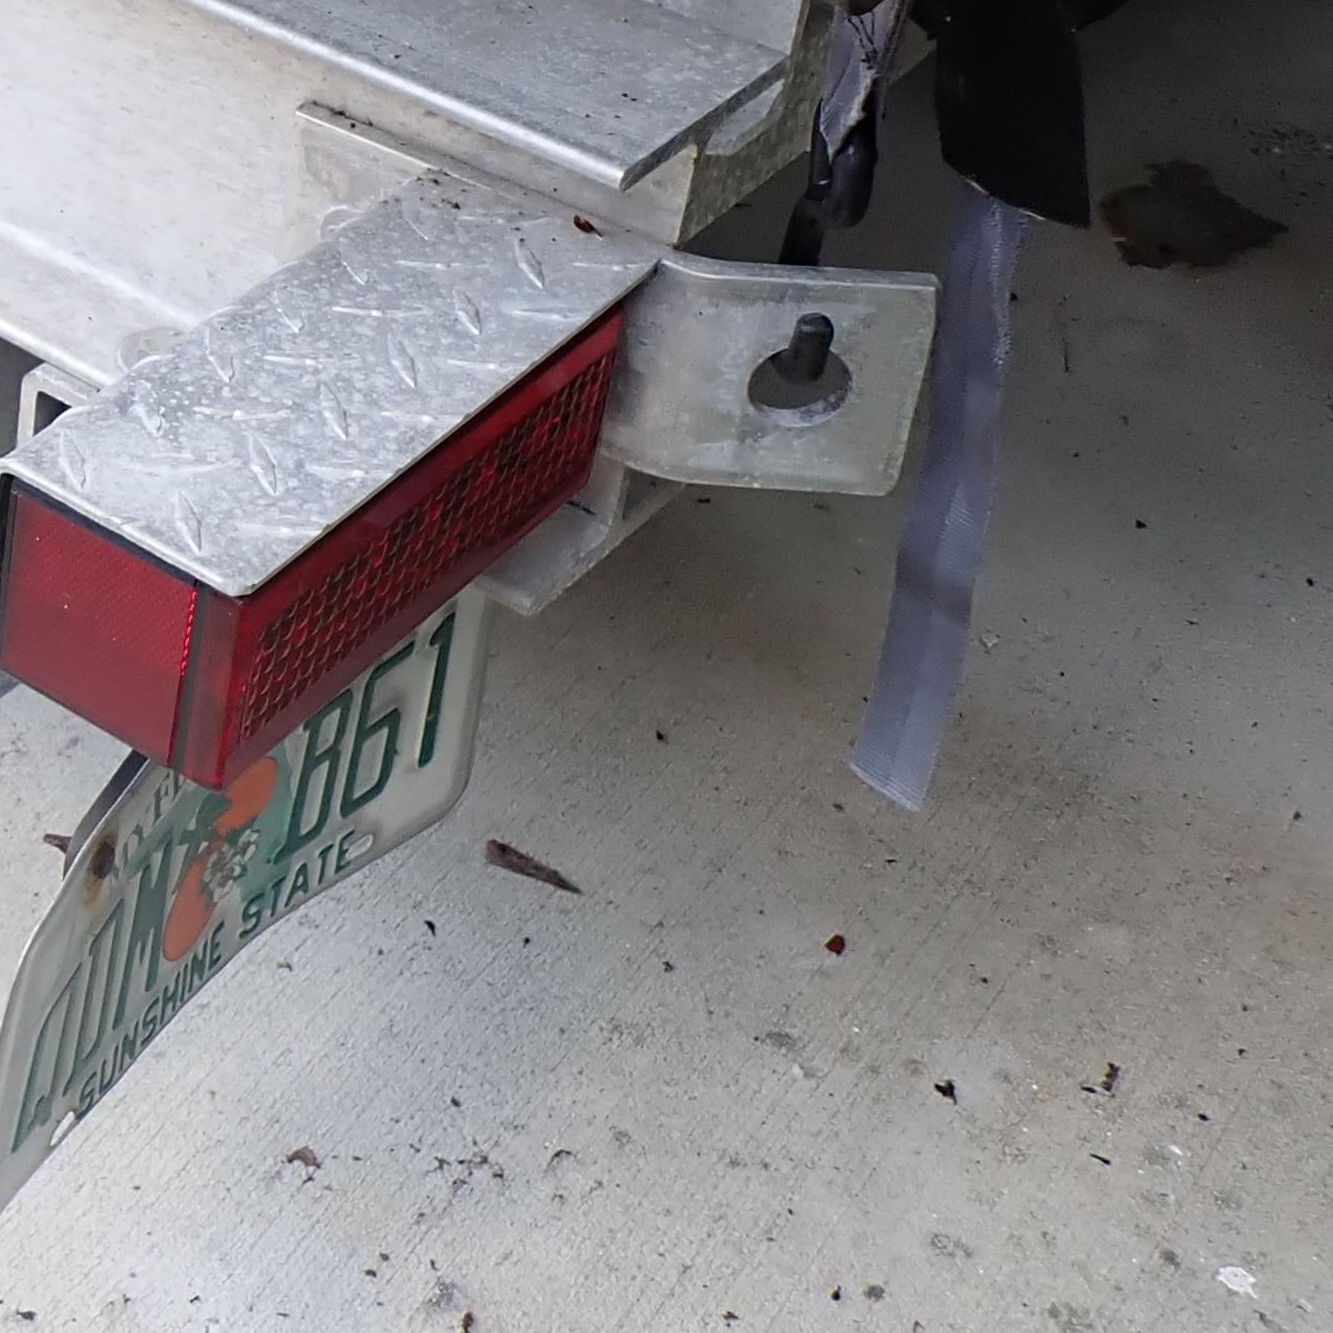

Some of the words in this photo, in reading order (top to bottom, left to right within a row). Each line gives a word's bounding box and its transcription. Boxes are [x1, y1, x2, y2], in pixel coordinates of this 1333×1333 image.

[268, 610, 457, 865] B61
[78, 919, 225, 1109] SUNSHINE
[238, 828, 356, 939] STATE
